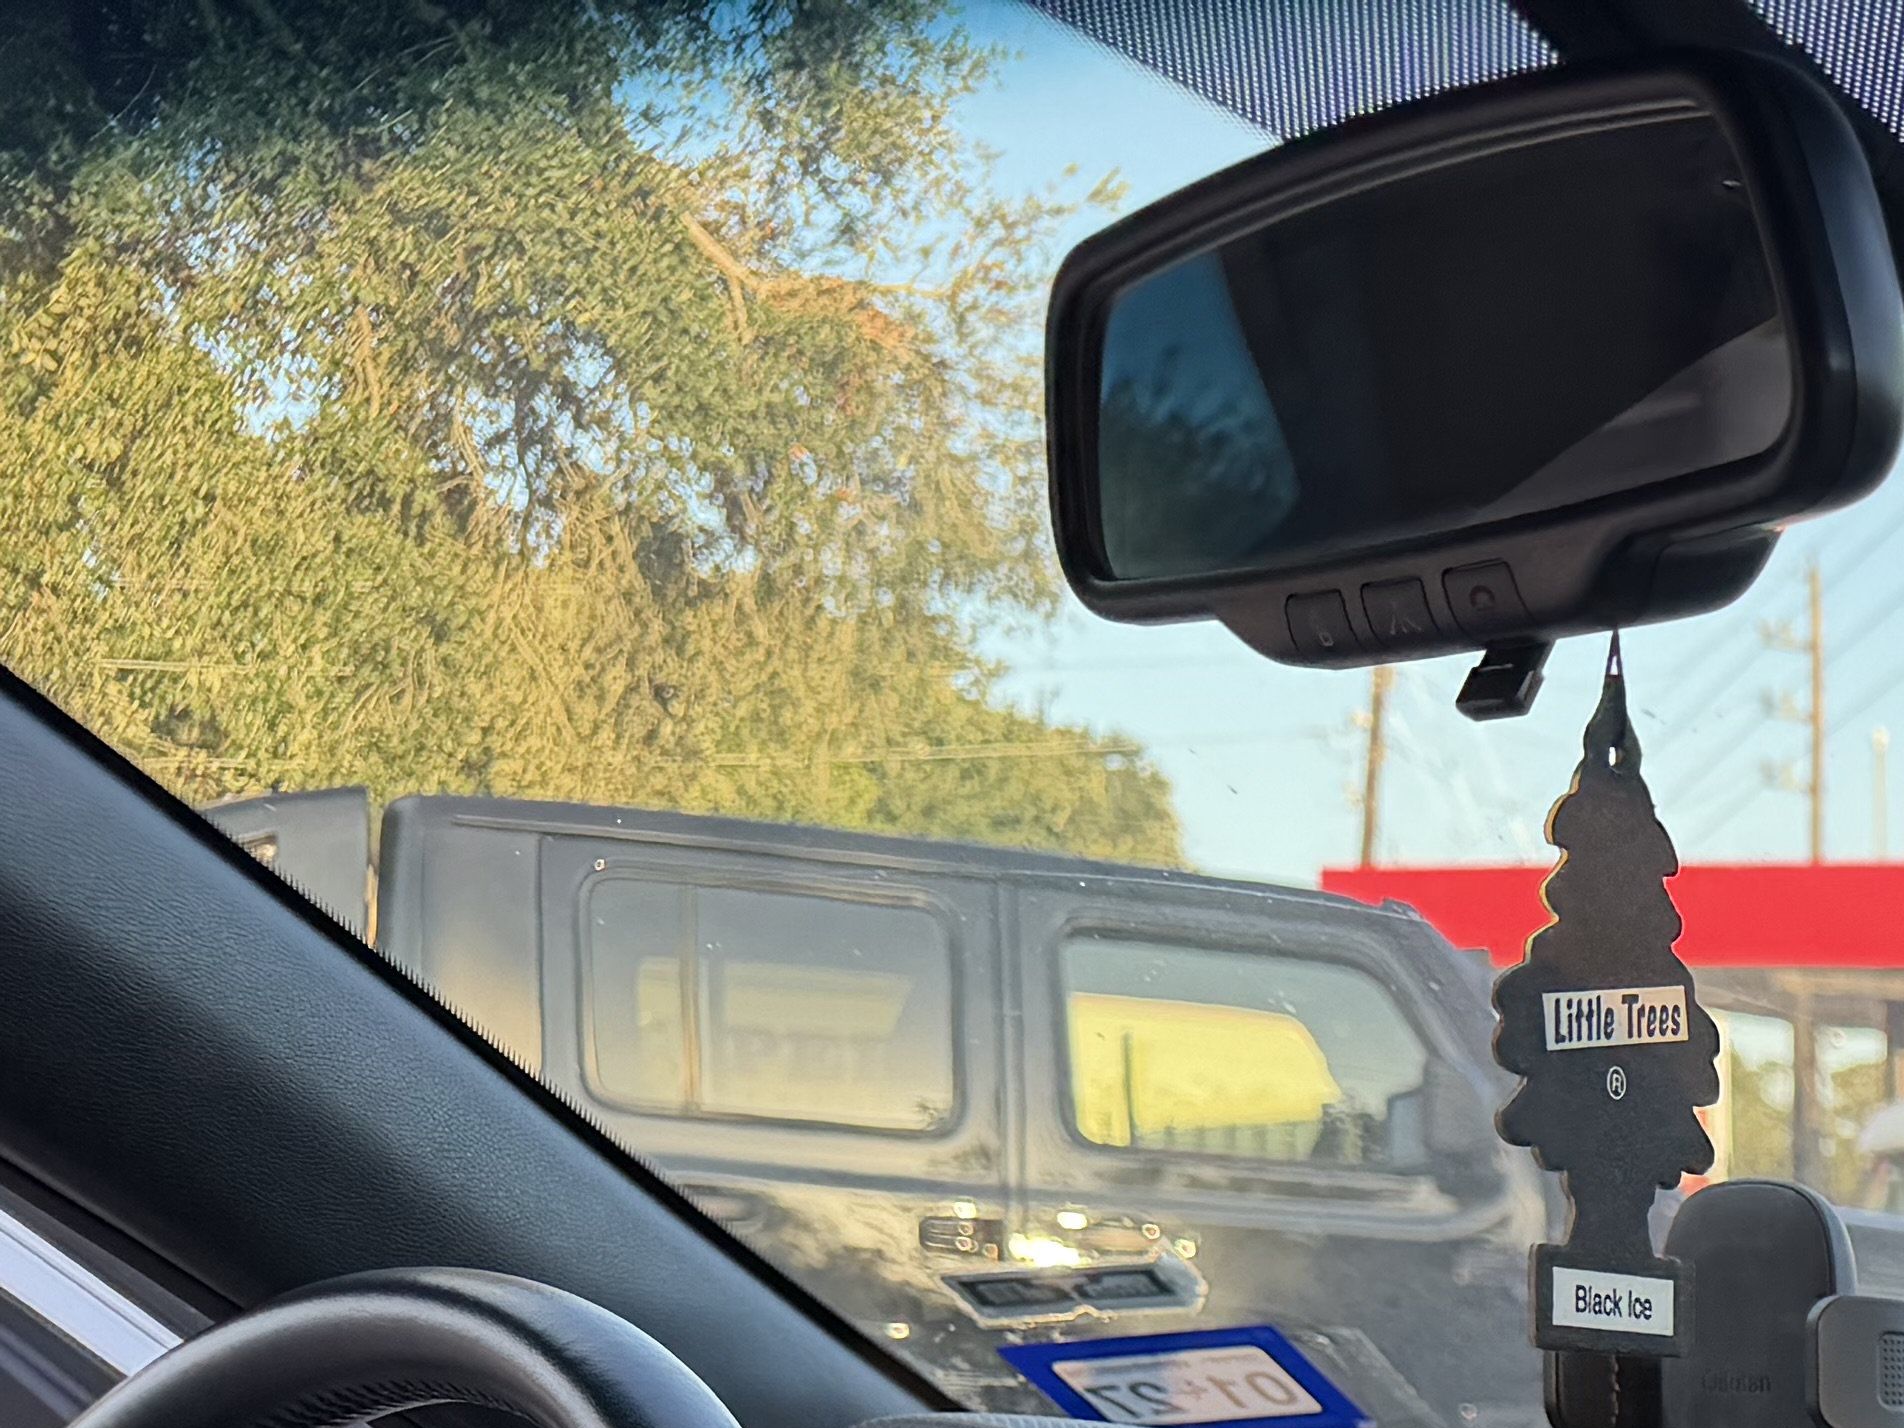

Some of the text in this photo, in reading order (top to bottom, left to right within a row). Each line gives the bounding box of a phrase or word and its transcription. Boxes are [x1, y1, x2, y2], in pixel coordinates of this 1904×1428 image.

[1554, 994, 1681, 1044] Little Trees
[1574, 1284, 1653, 1321] Black Ice
